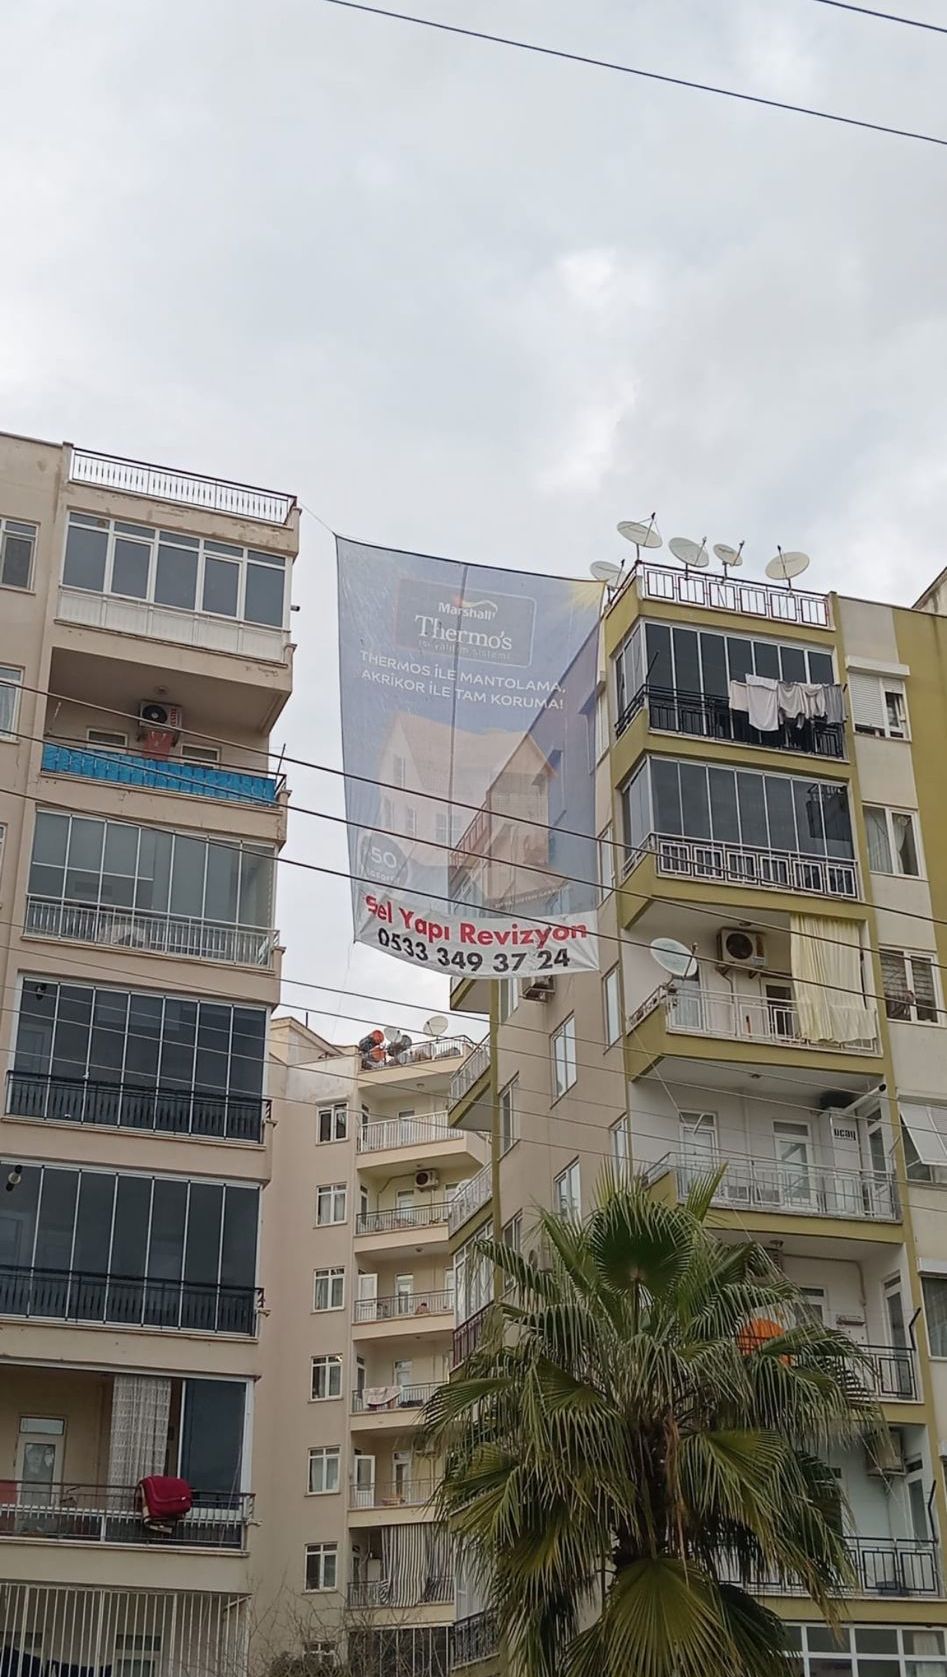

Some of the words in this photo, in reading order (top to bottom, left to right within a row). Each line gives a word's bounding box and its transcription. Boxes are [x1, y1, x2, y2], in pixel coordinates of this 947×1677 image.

[414, 615, 513, 650] Thermo's
[438, 602, 492, 621] Marshall
[360, 650, 431, 676] THERMOS
[434, 663, 457, 681] İLE
[460, 672, 567, 694] MANTOLAMA,
[361, 669, 425, 694] AKRİKOR
[429, 680, 451, 697] İLE
[454, 688, 487, 702] TAM
[491, 694, 564, 710] KORUMA!
[365, 895, 393, 924] Sel
[398, 907, 450, 943] Yapı
[460, 922, 588, 950] Revizyon
[378, 927, 429, 962] 0533
[436, 947, 483, 972] 349
[493, 952, 527, 973] 37
[536, 948, 571, 971] 24
